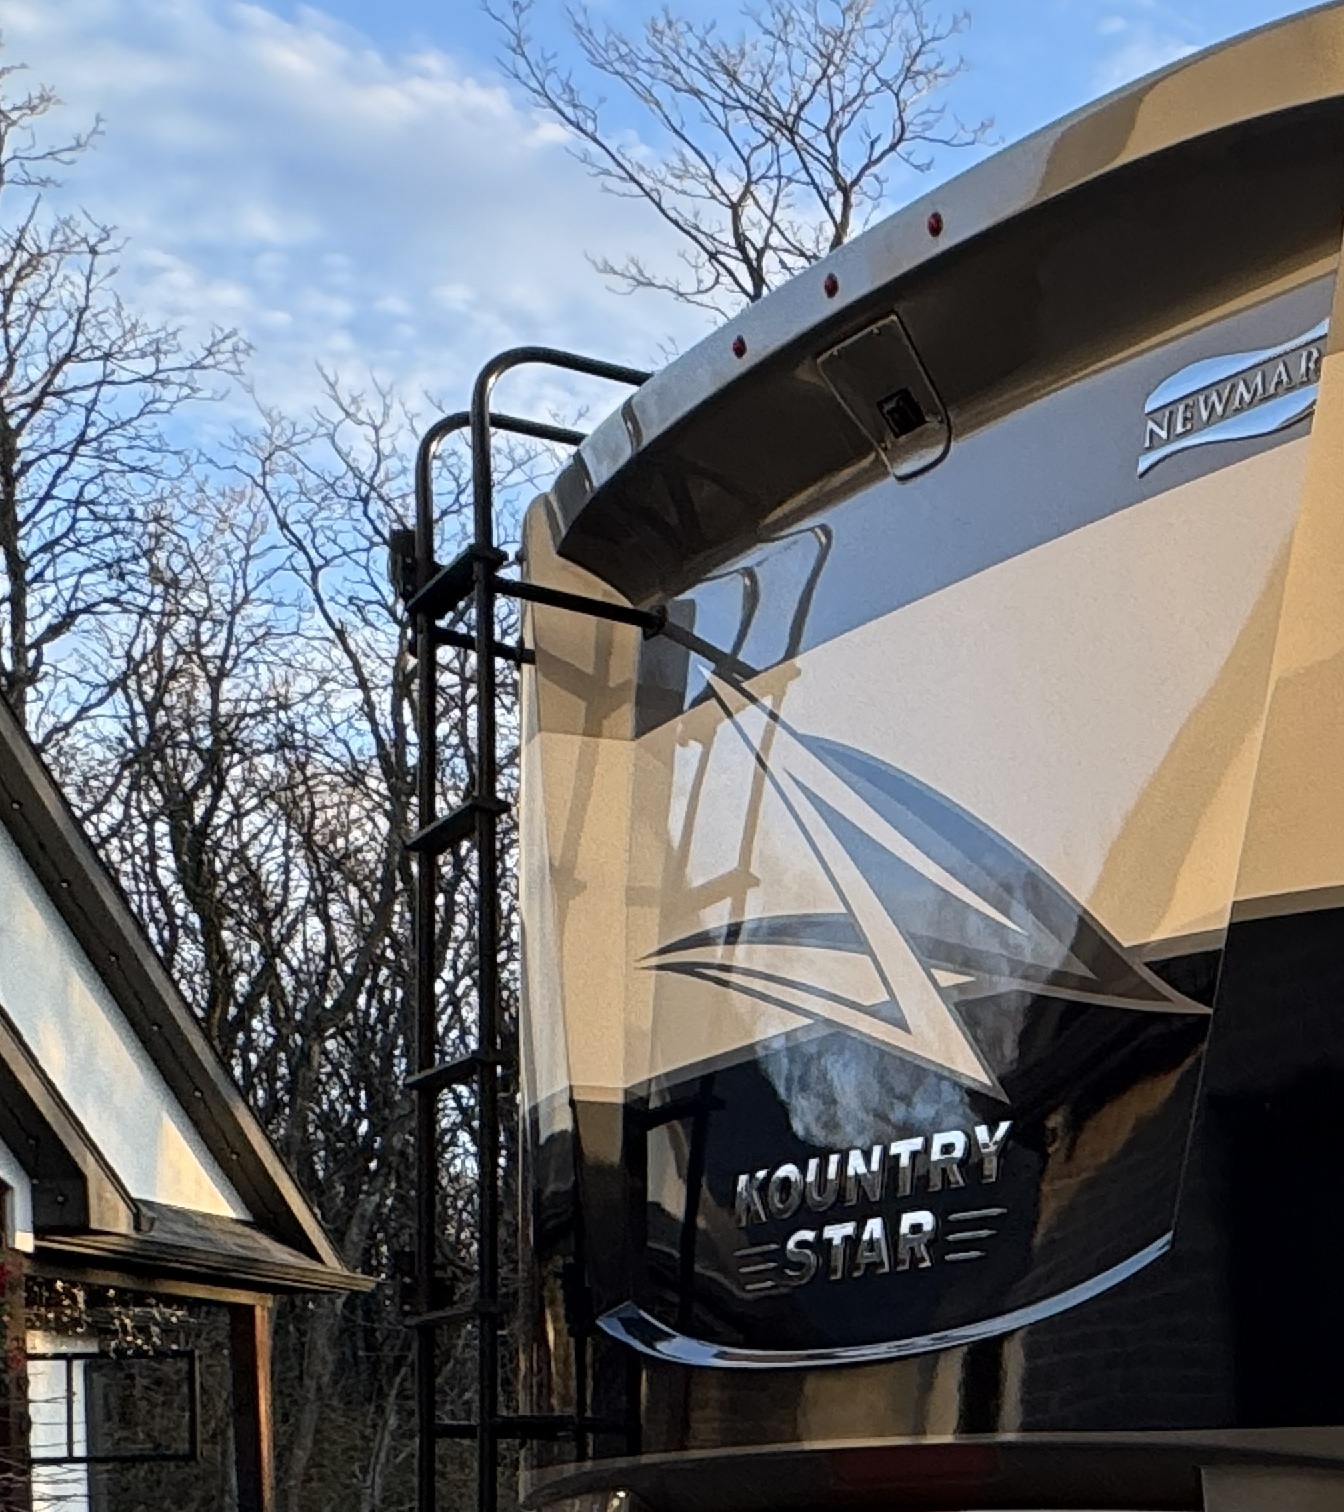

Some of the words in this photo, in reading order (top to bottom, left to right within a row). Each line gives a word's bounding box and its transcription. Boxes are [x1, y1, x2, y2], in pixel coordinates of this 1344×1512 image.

[1143, 347, 1322, 449] NEWMAR
[735, 1120, 1013, 1228] KOUNTRY
[782, 1209, 938, 1285] STAR
